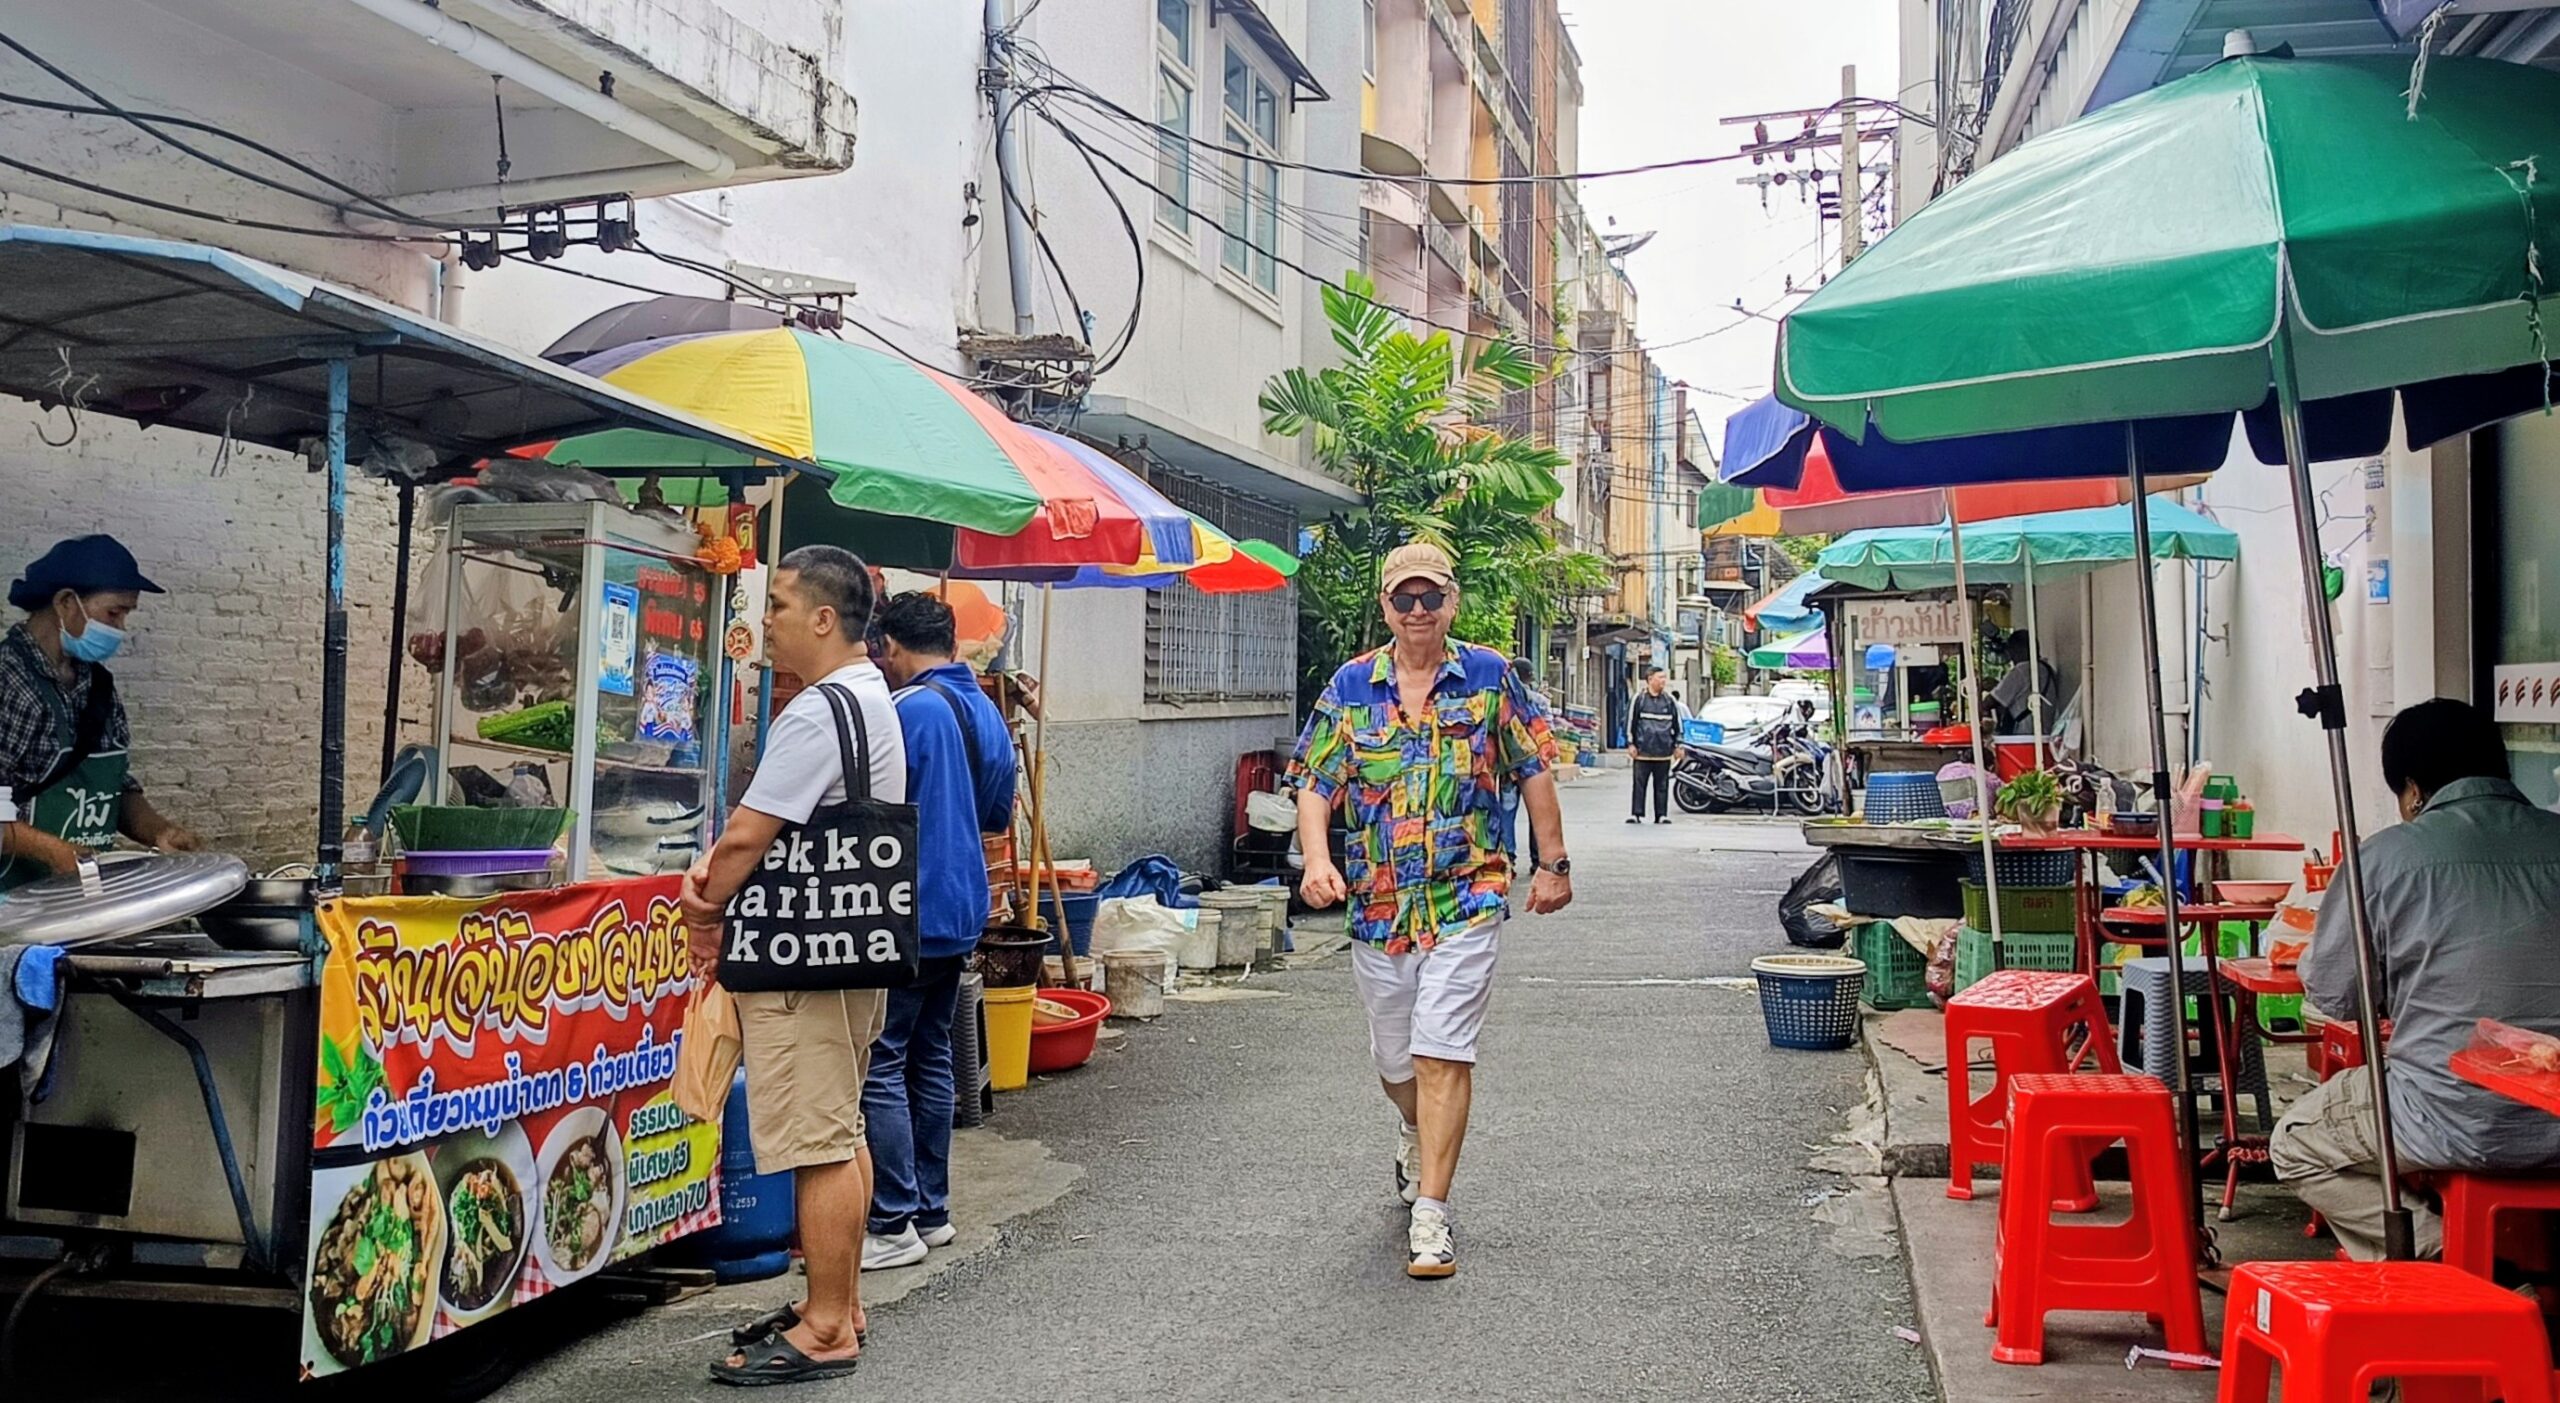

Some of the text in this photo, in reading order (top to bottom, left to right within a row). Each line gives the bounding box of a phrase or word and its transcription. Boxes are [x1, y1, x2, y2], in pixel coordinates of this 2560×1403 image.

[763, 829, 903, 874] ekko
[727, 920, 901, 967] koma
[685, 1178, 706, 1211] 70
